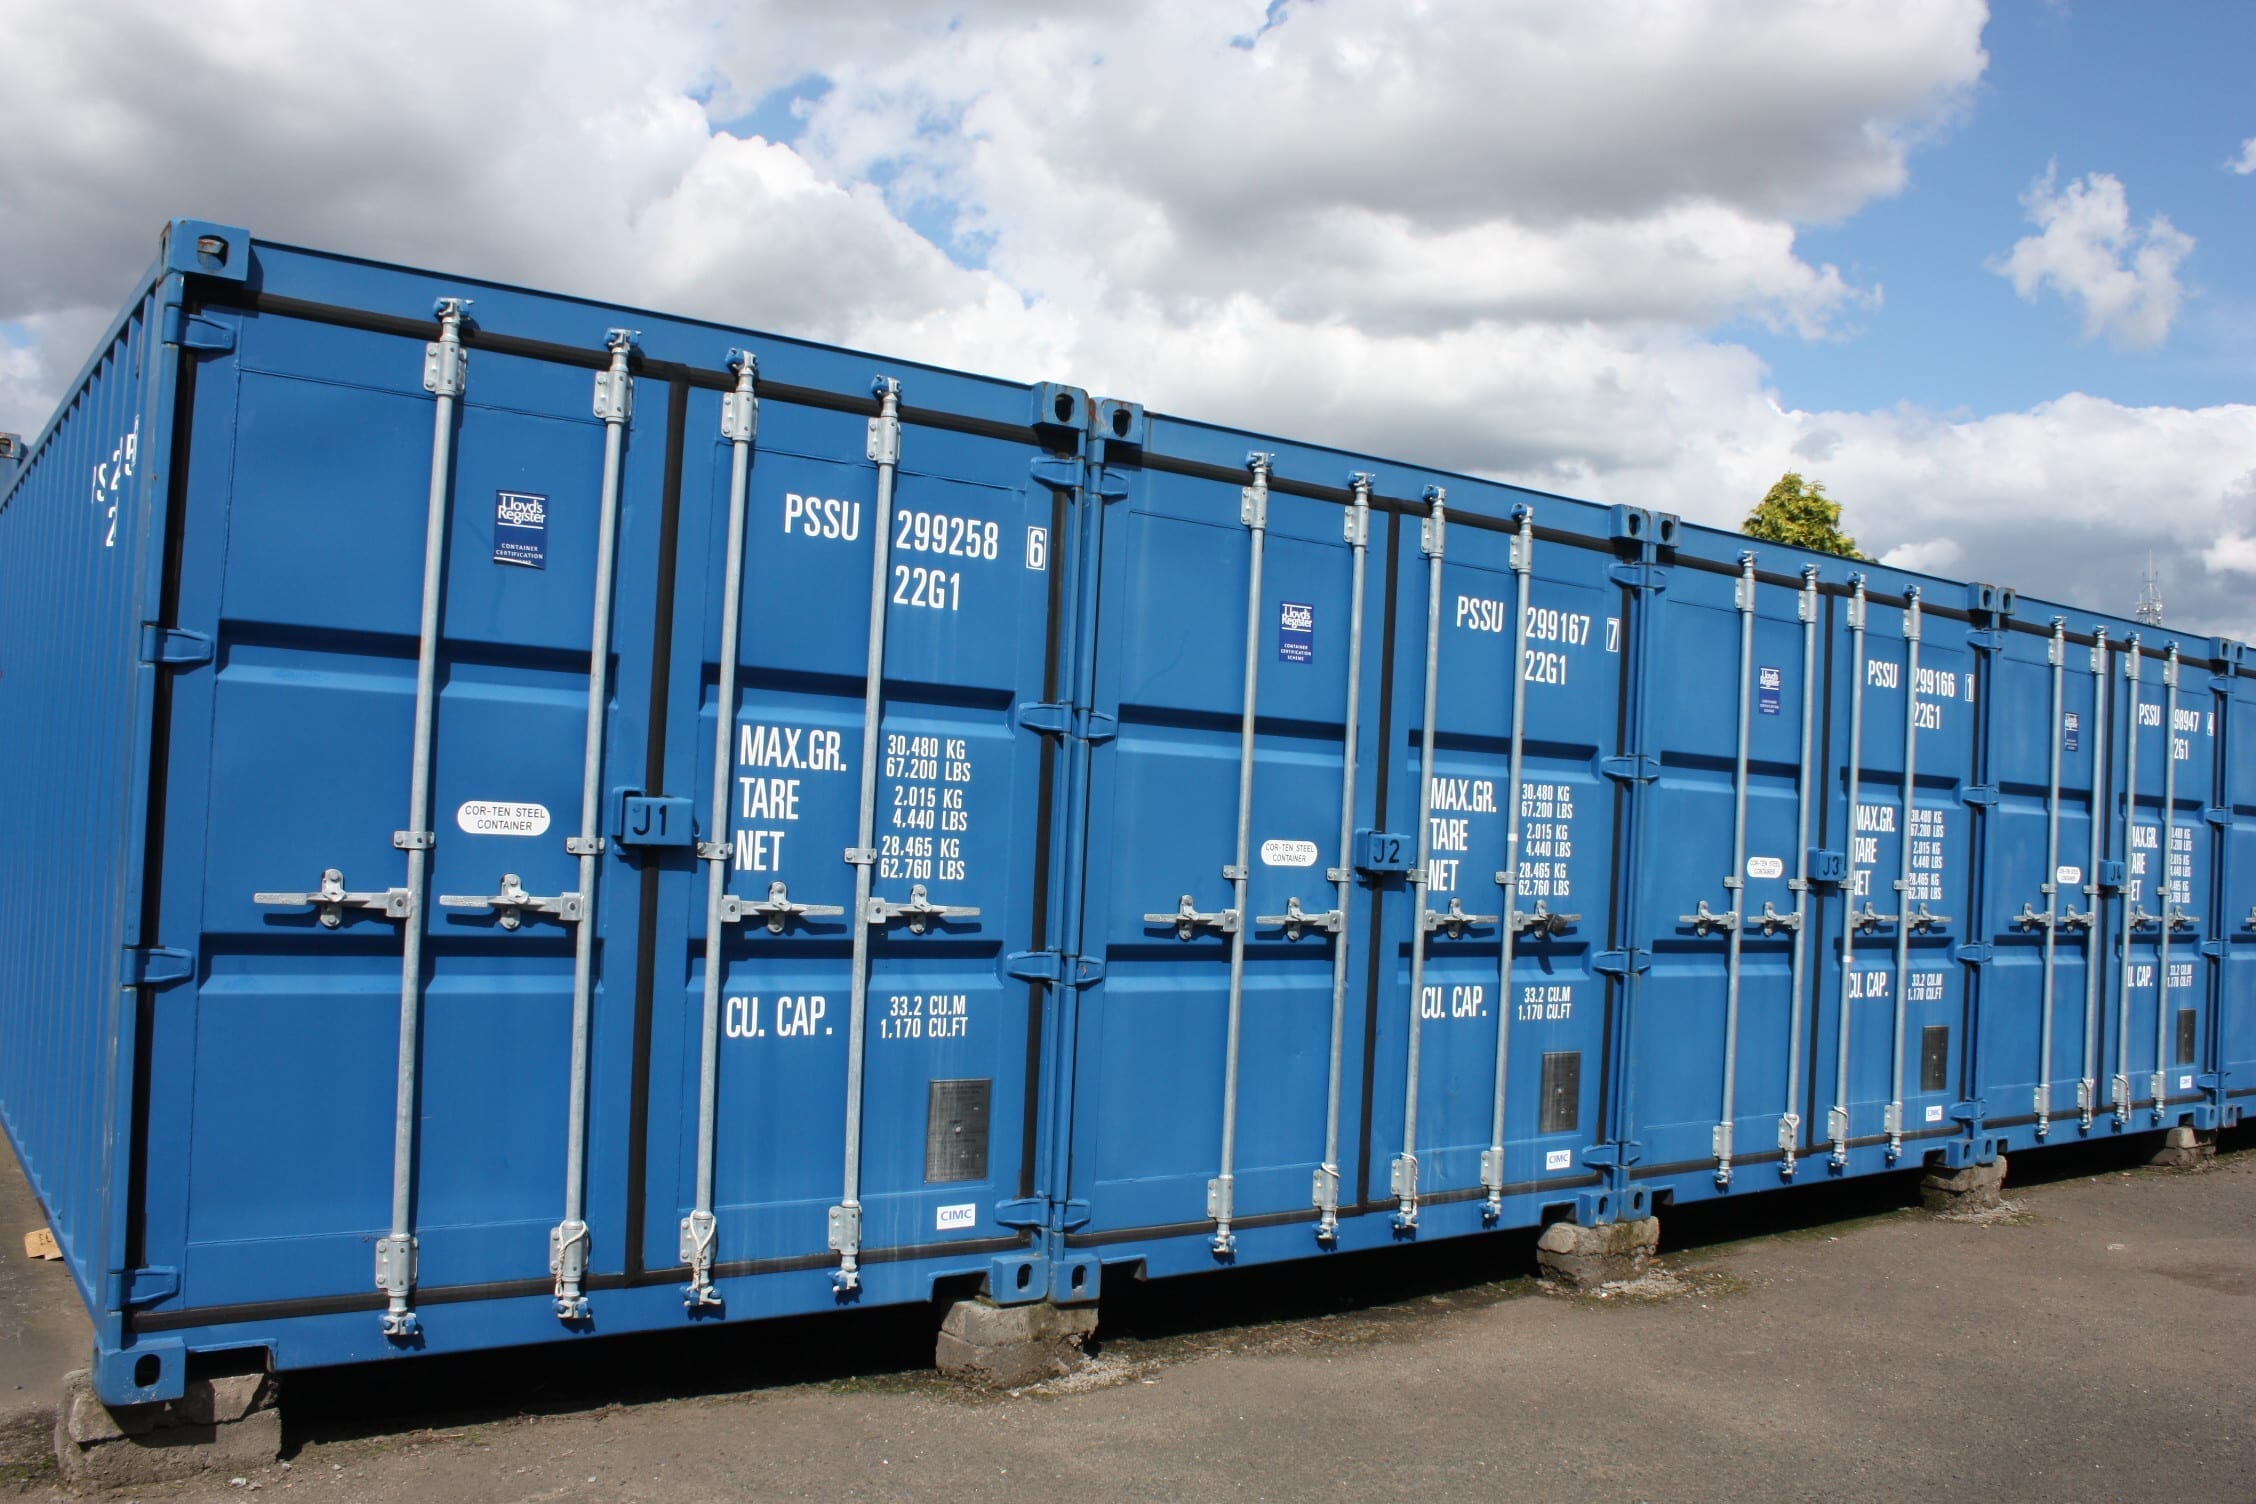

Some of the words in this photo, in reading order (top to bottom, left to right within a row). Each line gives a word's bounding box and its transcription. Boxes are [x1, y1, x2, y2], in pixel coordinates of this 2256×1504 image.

[498, 505, 546, 524] Register
[785, 493, 860, 541] PSSU
[896, 510, 999, 560] 299258
[1027, 528, 1045, 569] 6
[496, 549, 544, 560] CERTIFICATION
[501, 543, 538, 551] CONTAINER
[893, 565, 961, 612] 22G1
[1456, 595, 1504, 633] PSSU
[1526, 606, 1590, 646] 299167
[1607, 619, 1619, 651] 7
[1525, 650, 1566, 685] 22G1
[1868, 660, 1898, 688] PSSU
[2139, 703, 2160, 726] PSSU
[2174, 708, 2200, 732] 98947
[740, 725, 847, 772] MAX.GR.
[946, 739, 966, 760] KG
[2174, 738, 2189, 760] 2G1
[945, 761, 971, 782] LBS
[739, 776, 801, 820] TARE
[943, 788, 963, 809] KG
[1430, 777, 1497, 813] MAX.GR.
[1557, 785, 1570, 802] KG
[465, 805, 511, 817] COR-TEN
[515, 807, 546, 819] STEEL
[632, 804, 668, 837] J1
[941, 810, 968, 831] LBS
[1556, 802, 1573, 819] LBS
[477, 819, 532, 831] CONTAINER
[1430, 817, 1469, 851] TARE
[1555, 824, 1568, 840] KG
[940, 837, 960, 858] KG
[1266, 843, 1293, 852] COR-TEN
[1296, 844, 1315, 853] STEEL
[2132, 826, 2158, 849] AX.GR.
[735, 829, 785, 872] NET
[1272, 853, 1307, 863] CONTAINER
[1374, 838, 1400, 864] J2
[1555, 841, 1571, 858] LBS
[1855, 837, 1878, 863] TARE
[939, 860, 965, 881] LBS
[1428, 859, 1460, 891] NET
[1554, 862, 1567, 879] KG
[1823, 856, 1840, 876] J3
[1553, 880, 1570, 896] LBS
[2131, 879, 2142, 902] ET
[1866, 971, 1889, 998] CAP.
[2127, 965, 2135, 987] U.
[2136, 965, 2153, 987] CAP.
[1421, 986, 1445, 1019] CU.
[1452, 985, 1487, 1018] CAP.
[1524, 986, 1544, 1003] 33.2
[1547, 986, 1571, 1002] CU.M
[890, 995, 923, 1016] 33.2
[929, 995, 966, 1016] CU.M
[1546, 1003, 1572, 1020] CU.FT
[725, 996, 765, 1038] CU.
[776, 996, 833, 1037] CAP.
[928, 1016, 969, 1037] CU.FT
[940, 1208, 973, 1222] CIMC
